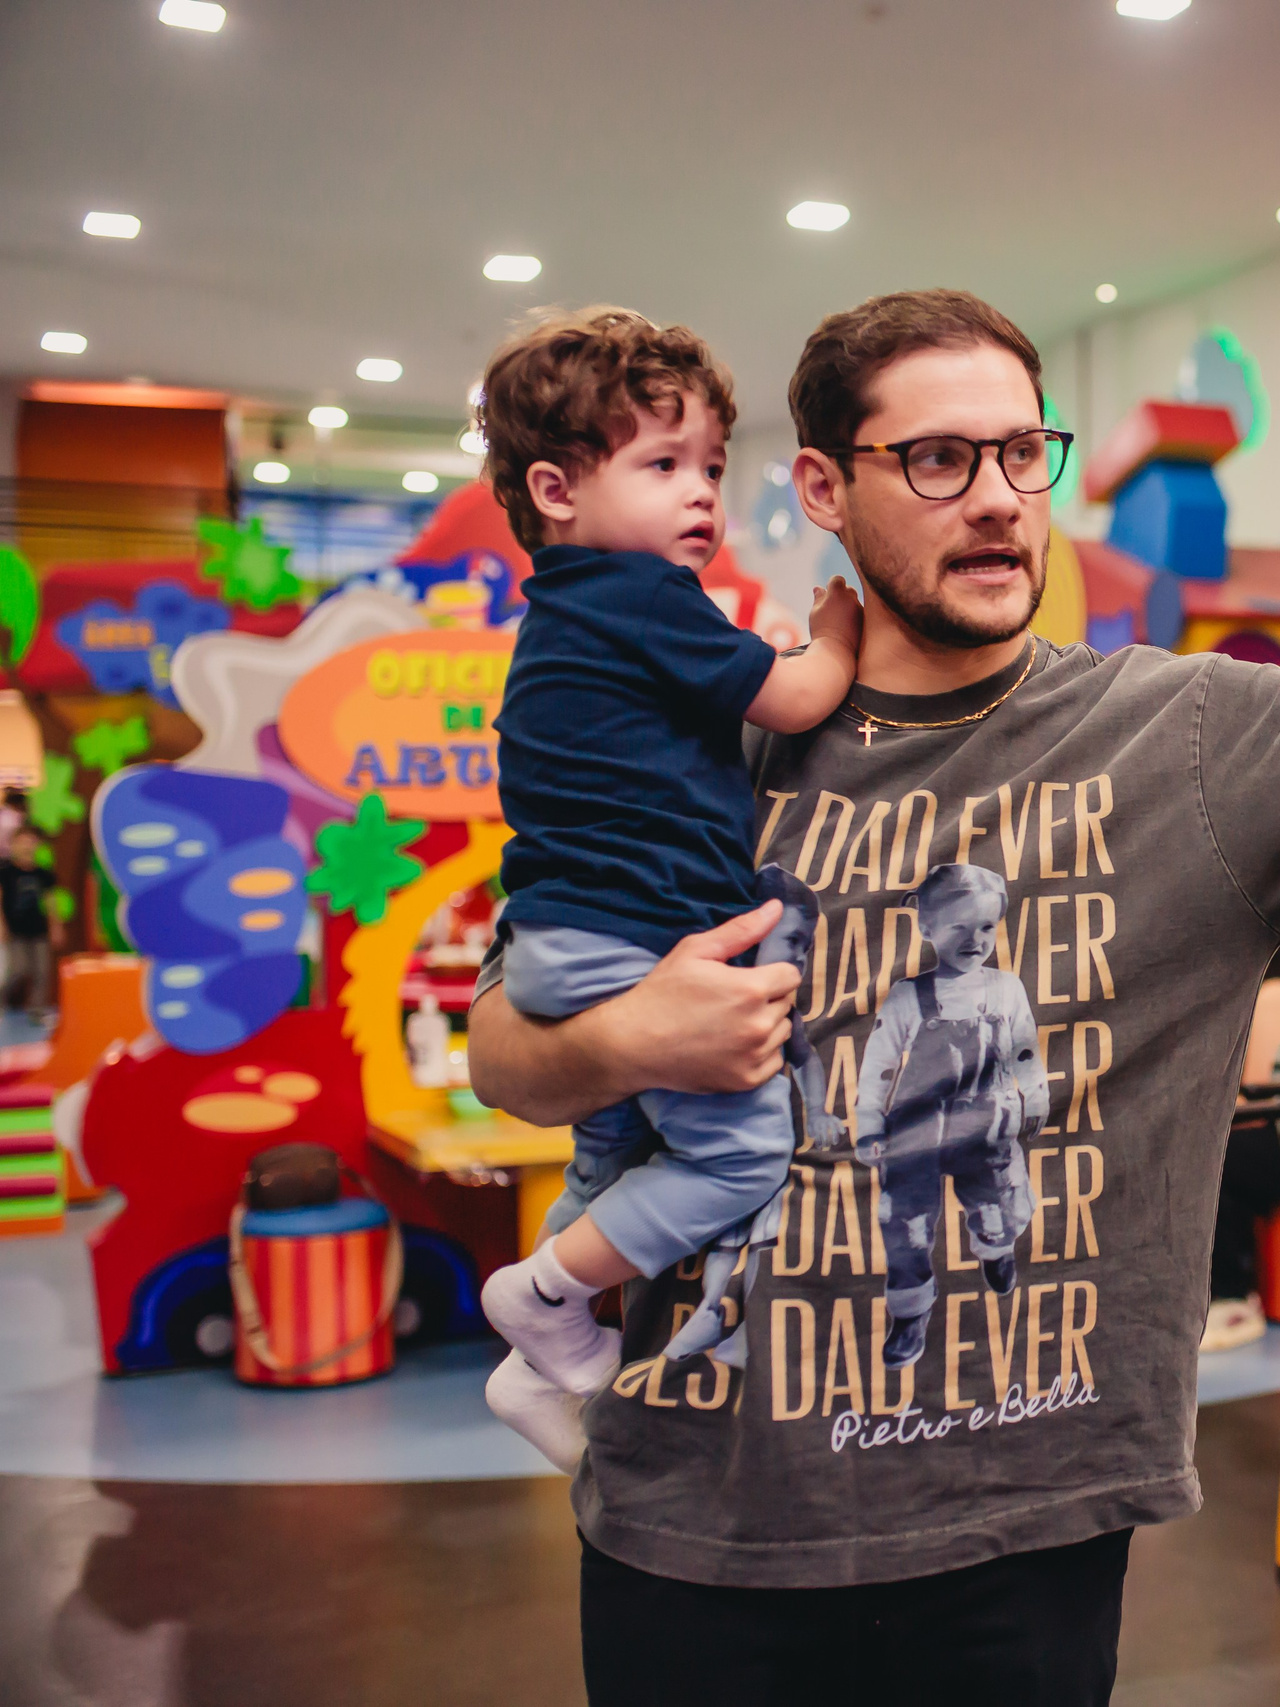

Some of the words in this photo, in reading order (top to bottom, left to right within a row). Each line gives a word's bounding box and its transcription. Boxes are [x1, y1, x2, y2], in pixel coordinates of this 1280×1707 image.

[366, 648, 513, 698] OFICI
[344, 741, 496, 788] ART
[795, 789, 938, 893] DAD
[956, 774, 1115, 882] EVER
[995, 892, 1116, 1004] VER
[941, 1145, 1104, 1271] EER
[770, 1296, 915, 1421] DAD
[944, 1280, 1098, 1411] EVER
[831, 1403, 962, 1452] Pietro
[968, 1406, 995, 1431] e
[998, 1372, 1100, 1426] Bella
